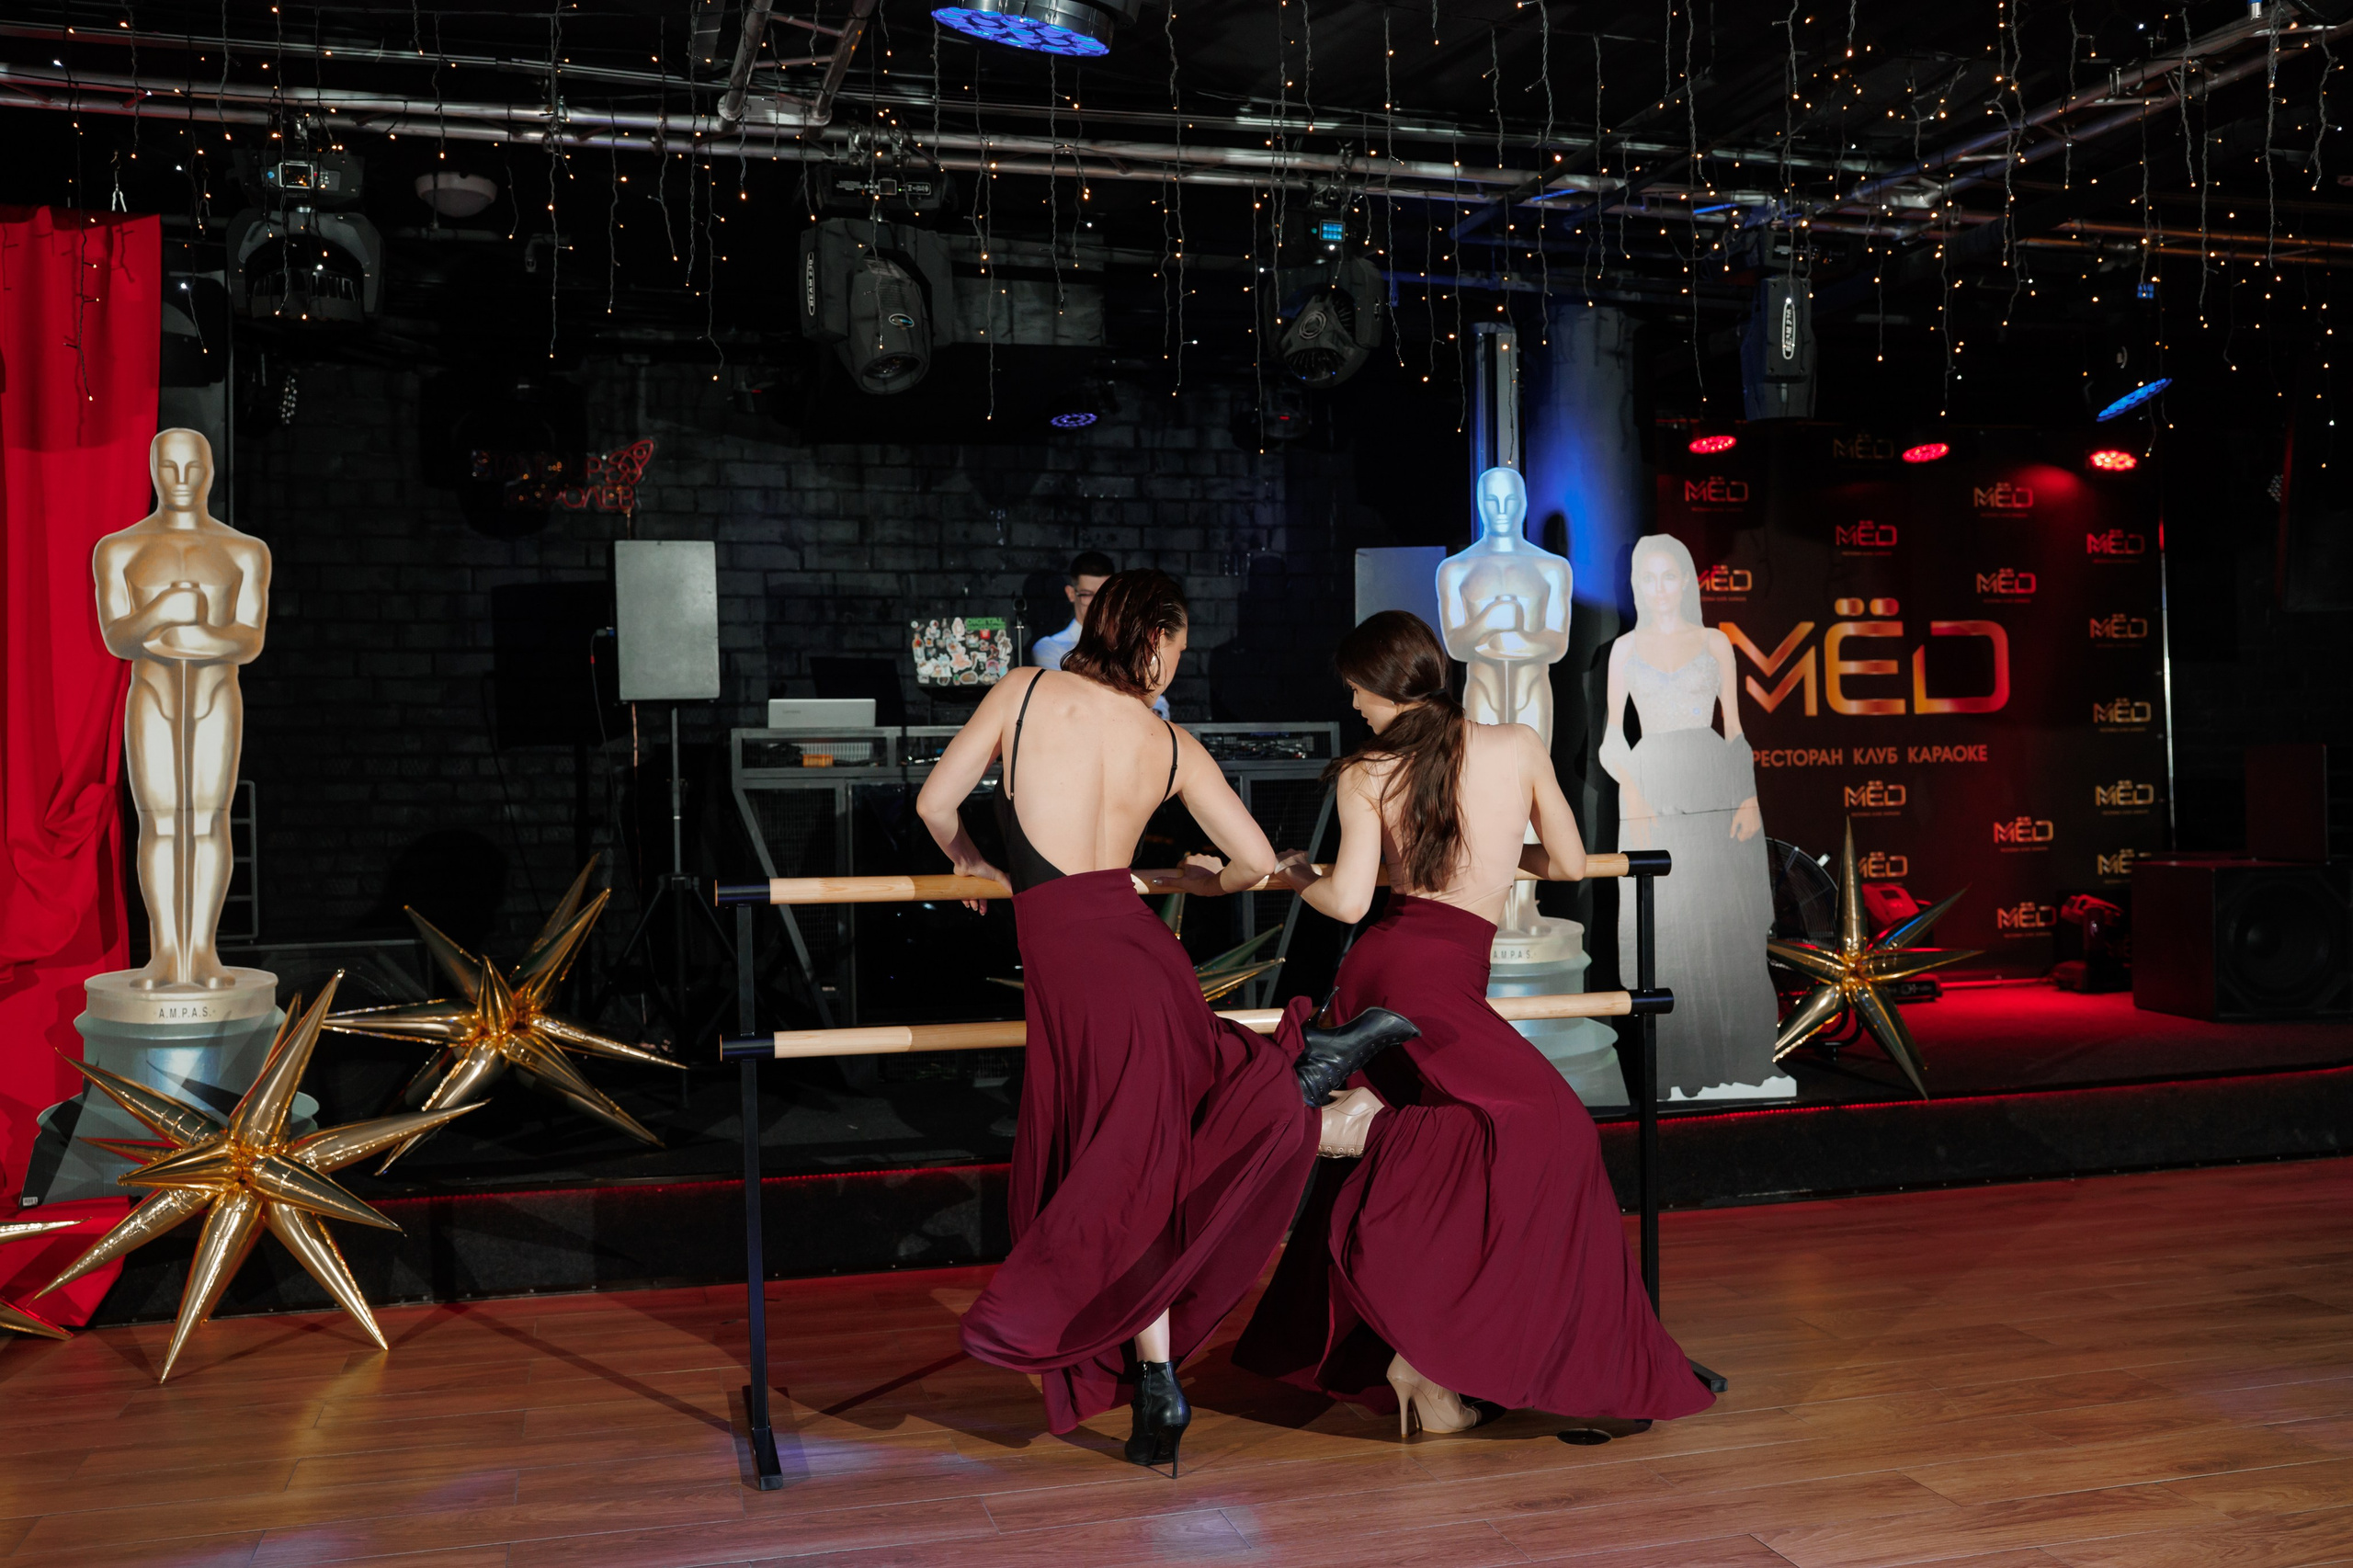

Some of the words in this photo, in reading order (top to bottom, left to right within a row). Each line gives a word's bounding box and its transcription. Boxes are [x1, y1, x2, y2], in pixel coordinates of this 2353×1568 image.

[1753, 747, 1843, 767] РЕСТОРАН
[1853, 746, 1898, 765] КЛУБ
[1907, 744, 1988, 764] КАРАОКЕ
[159, 1006, 212, 1019] A.M.P.A.S.
